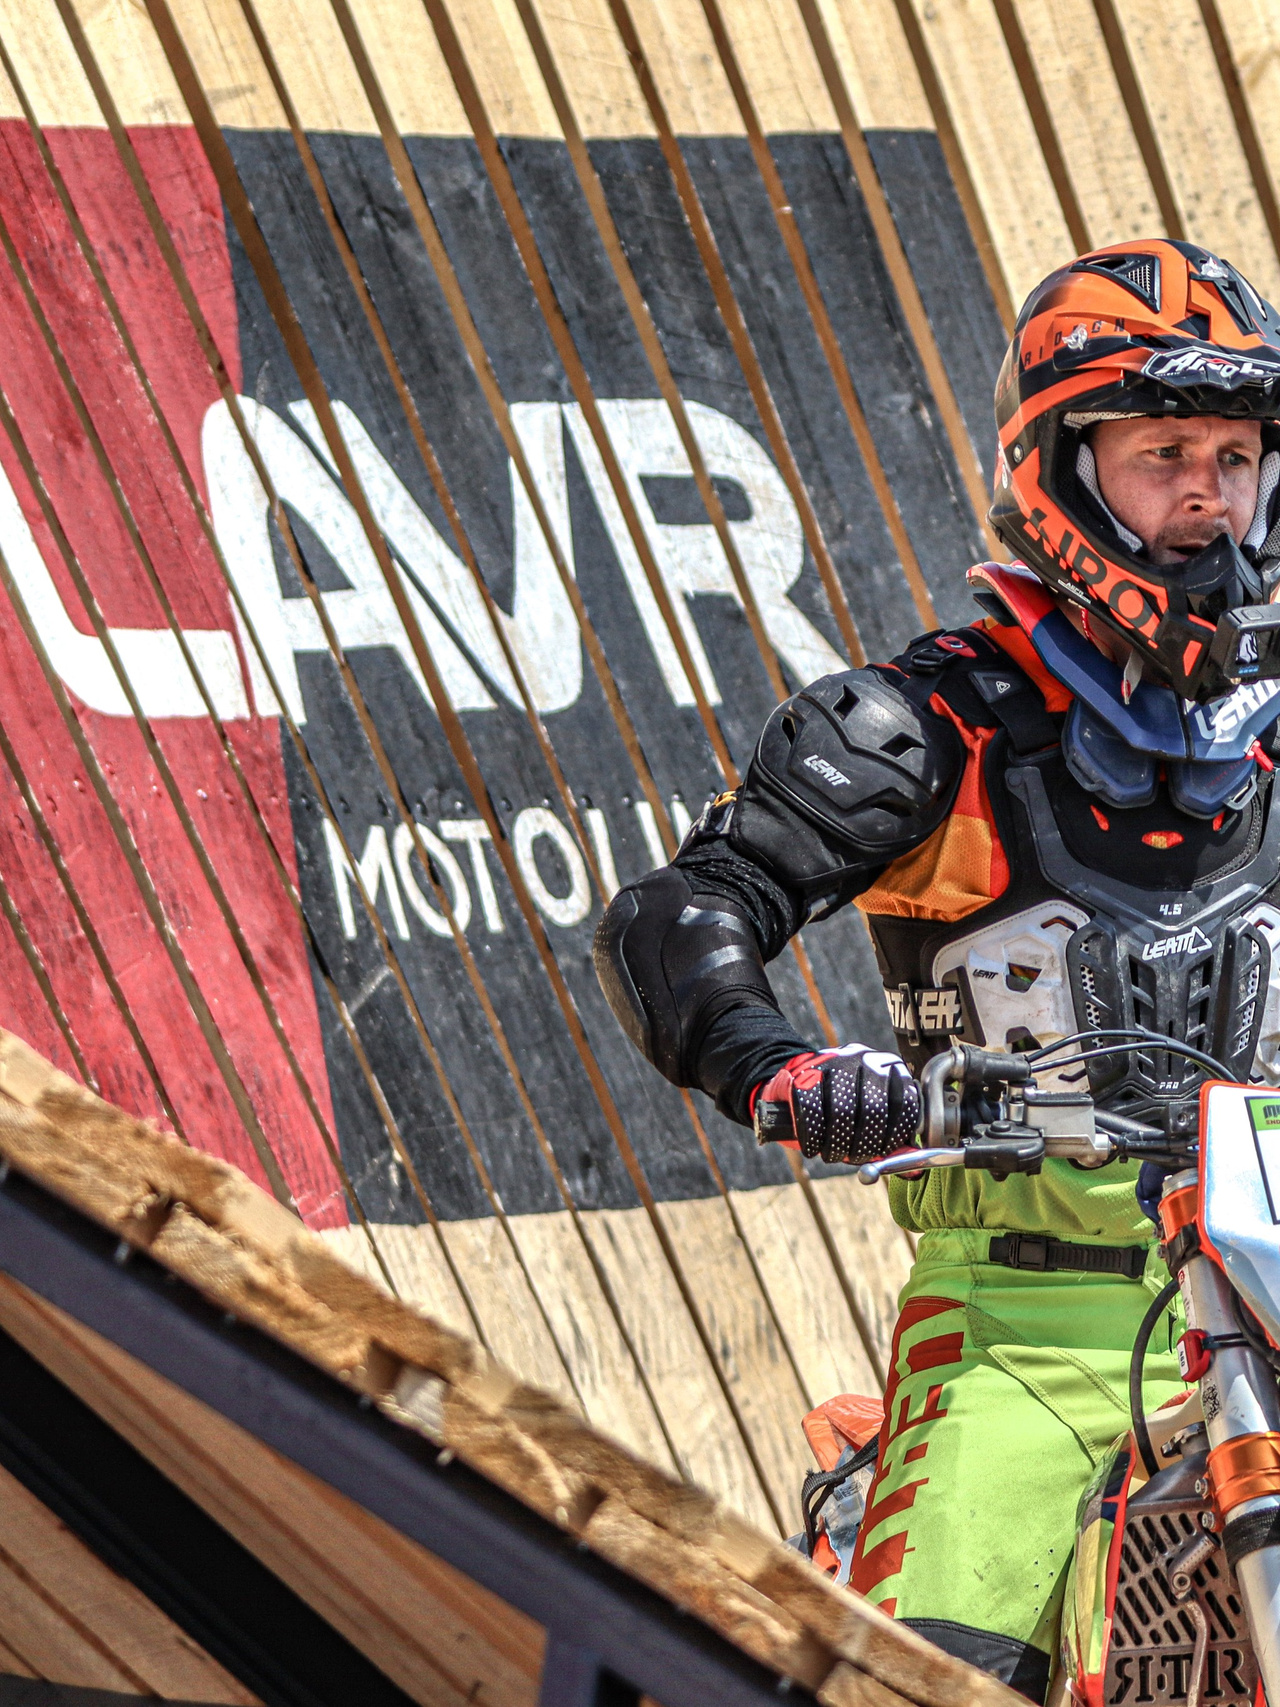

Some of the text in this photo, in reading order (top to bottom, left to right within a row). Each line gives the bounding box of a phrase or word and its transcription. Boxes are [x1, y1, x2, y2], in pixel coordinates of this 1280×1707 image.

[803, 754, 851, 786] LEATT
[1159, 903, 1183, 915] 4.5
[1142, 930, 1194, 960] LEATT
[1159, 1081, 1180, 1090] PRO
